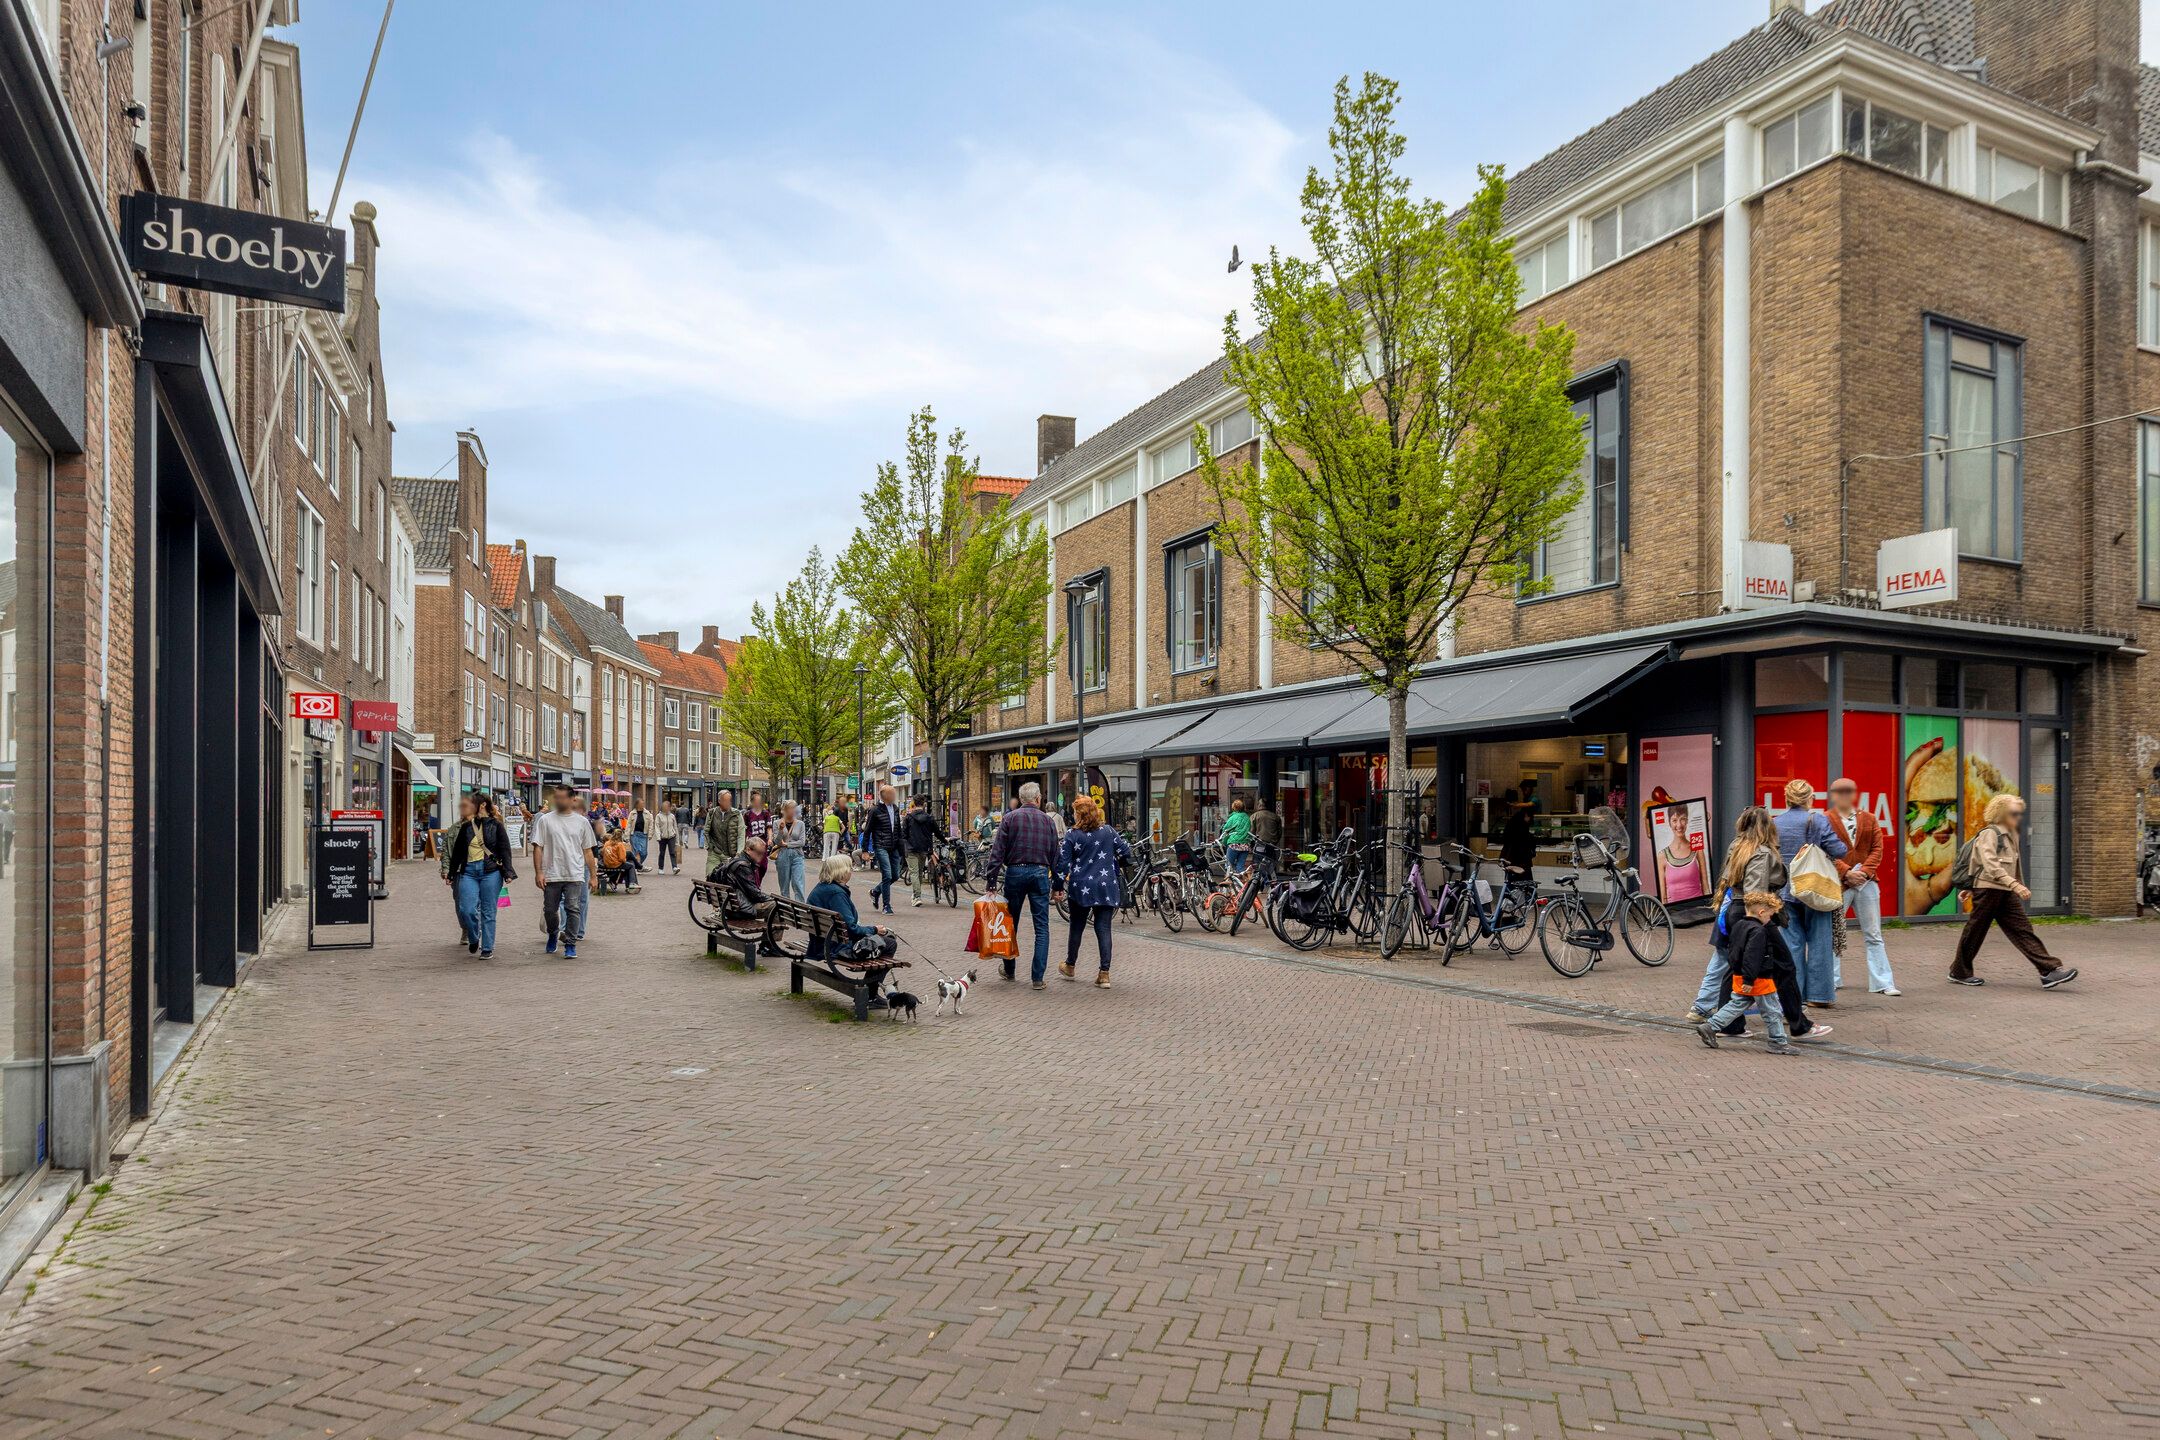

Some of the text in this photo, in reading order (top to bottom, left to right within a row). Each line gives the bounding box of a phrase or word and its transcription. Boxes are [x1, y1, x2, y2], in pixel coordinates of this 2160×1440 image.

[142, 207, 336, 290] shoeby
[1745, 576, 1789, 596] HEMA
[1886, 567, 1946, 592] HEMA
[356, 710, 396, 722] paprika
[465, 739, 480, 748] Etos
[1007, 752, 1039, 771] xenos
[750, 819, 766, 835] 25
[324, 838, 361, 849] shoeby
